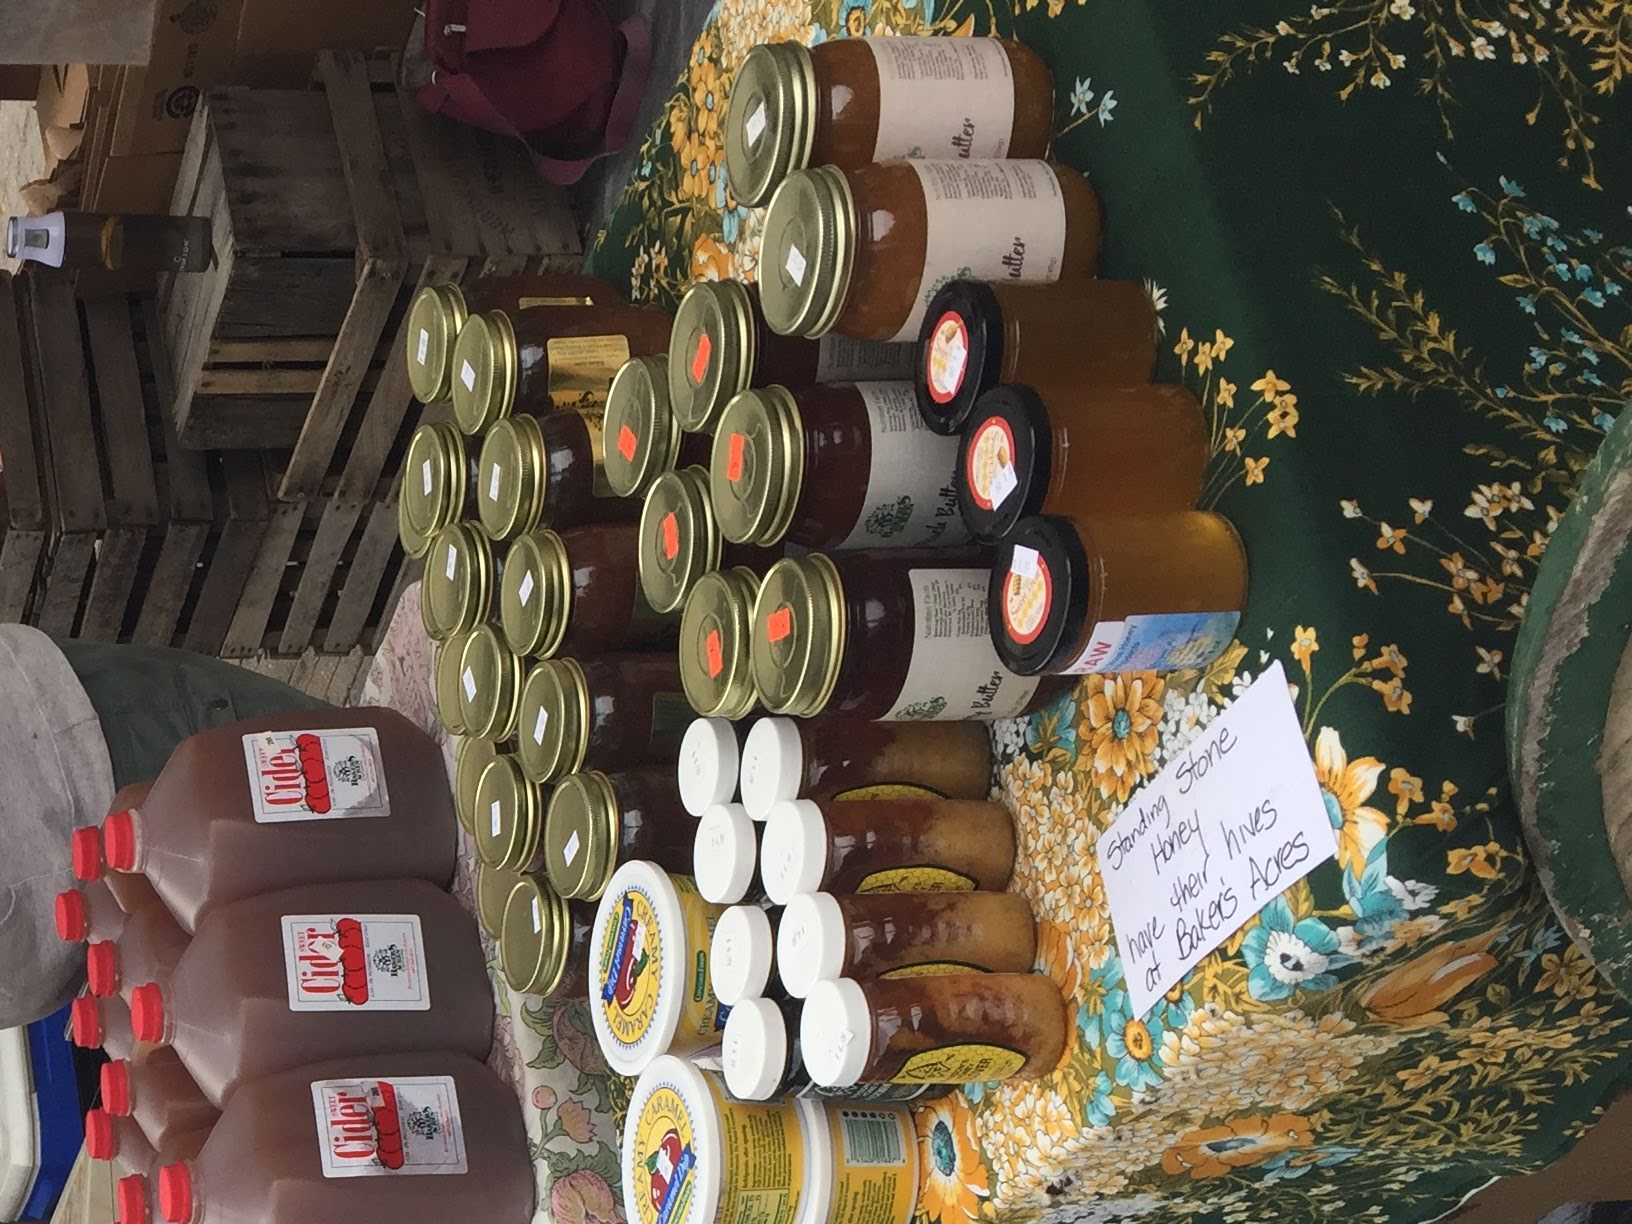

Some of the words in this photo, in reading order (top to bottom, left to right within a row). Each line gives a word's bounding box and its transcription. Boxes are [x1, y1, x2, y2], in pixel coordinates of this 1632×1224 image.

[952, 127, 976, 159] utter
[1002, 236, 1026, 279] utter
[970, 670, 1004, 708] Butter
[1106, 794, 1171, 872] Standing
[1175, 726, 1239, 795] Stone
[1149, 808, 1203, 876] Honey
[1125, 915, 1166, 964] have
[1168, 838, 1212, 915] their
[1219, 798, 1279, 860] hives
[1144, 954, 1162, 993] at
[1175, 877, 1240, 961] Baker's
[1247, 830, 1311, 900] Acres
[636, 899, 659, 981] CREAMY
[329, 1091, 375, 1159] Cider
[644, 1094, 688, 1138] CARAMEL
[636, 1136, 654, 1224] CREAMY
